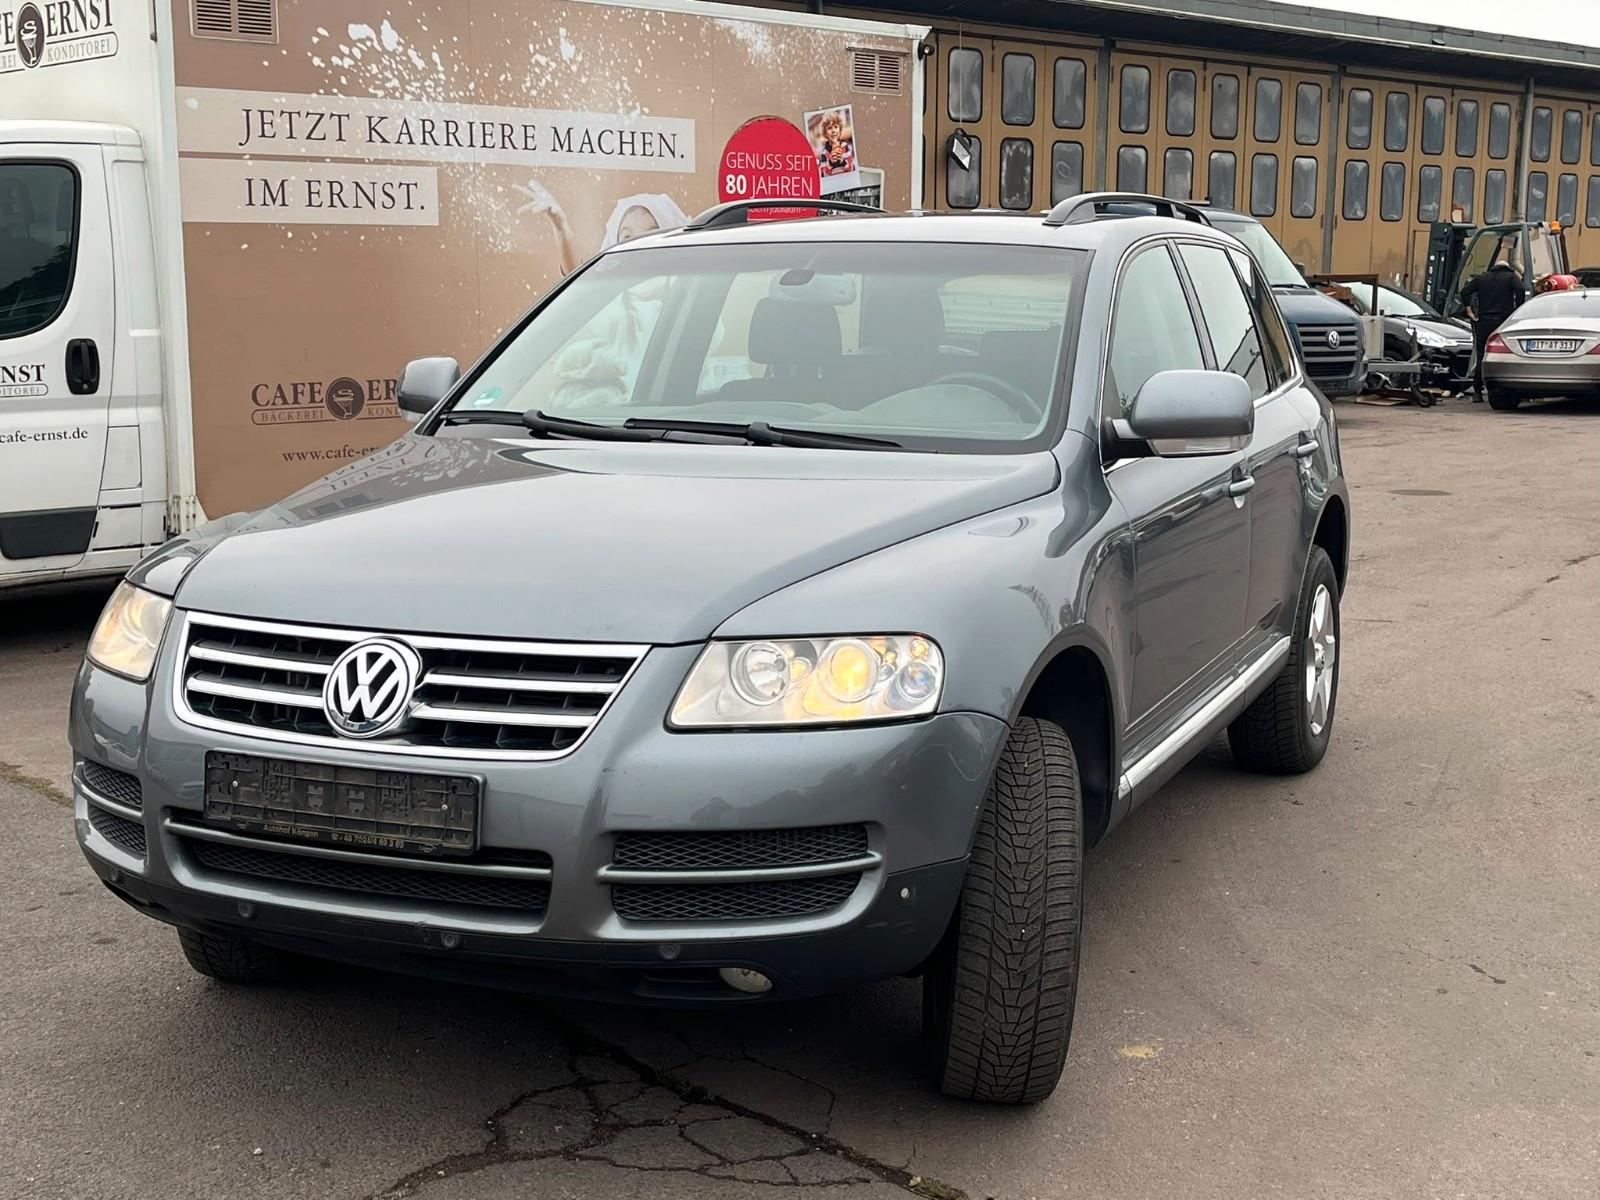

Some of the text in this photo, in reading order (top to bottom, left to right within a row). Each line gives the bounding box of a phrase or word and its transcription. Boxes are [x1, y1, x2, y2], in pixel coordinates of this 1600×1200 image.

[47, 38, 110, 62] KONDITOREI
[238, 108, 686, 160] JETZT KARRIERE MACHEN.
[726, 151, 813, 171] GENUSS SEIT
[244, 178, 426, 211] IM ERNST.
[725, 174, 813, 198] 80 JAHREN
[251, 382, 324, 407] CAFE
[282, 444, 381, 462] www.cafe-er
